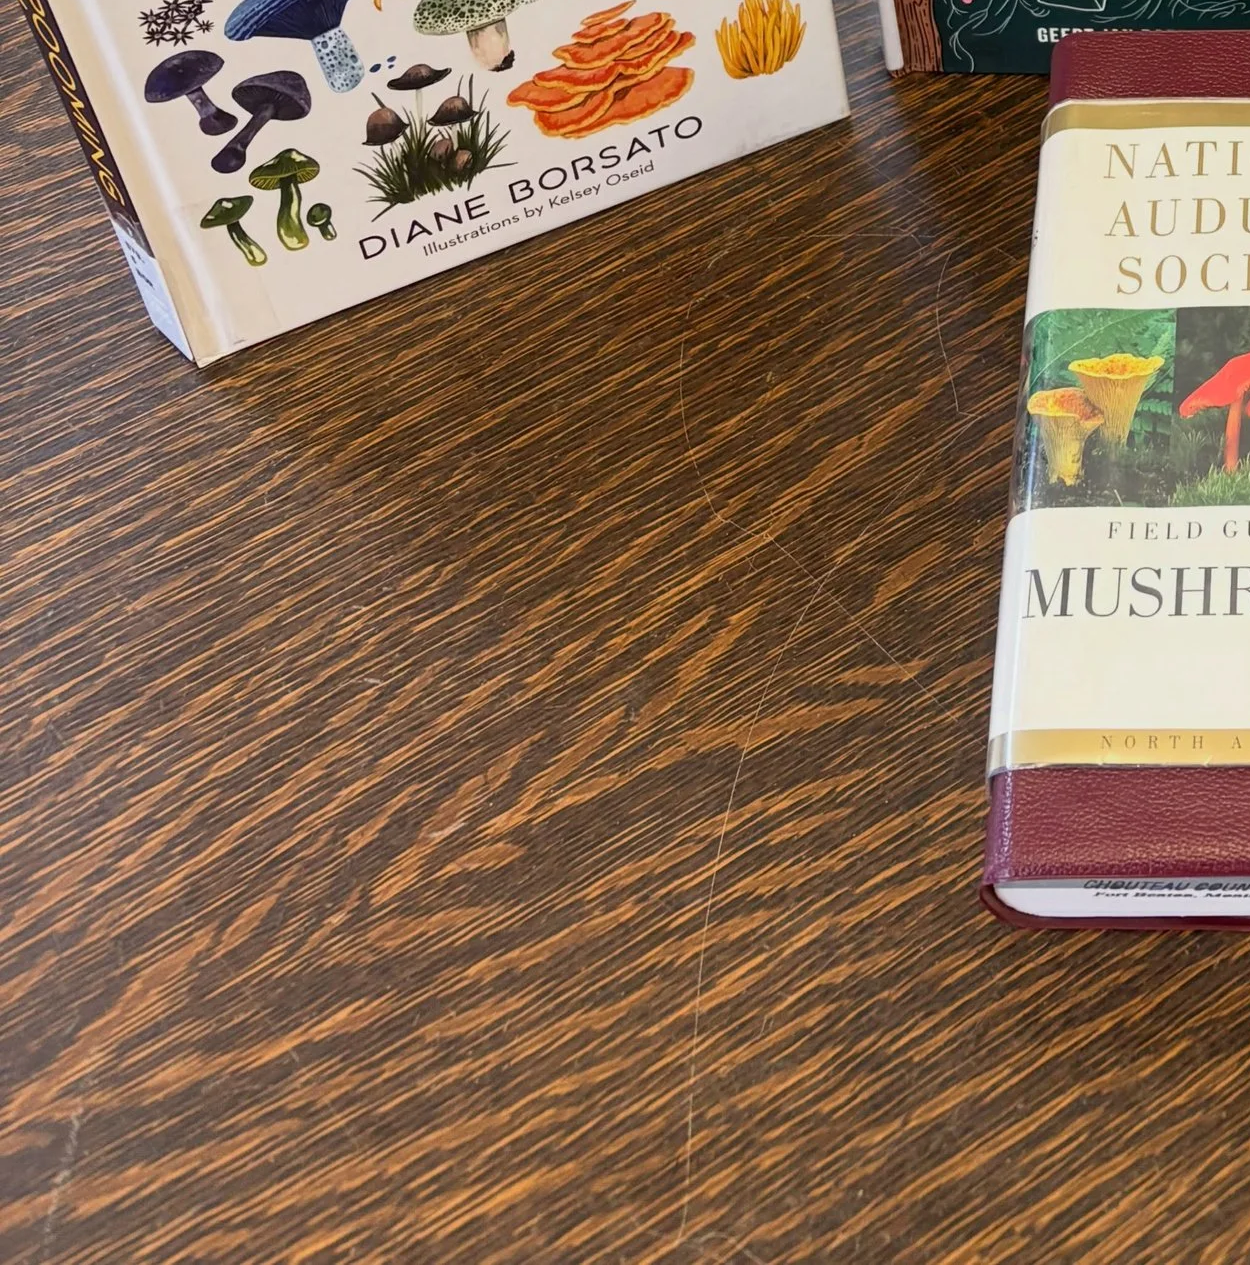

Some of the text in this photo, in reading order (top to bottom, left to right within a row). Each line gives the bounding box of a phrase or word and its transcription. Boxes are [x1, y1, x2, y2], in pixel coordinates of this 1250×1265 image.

[358, 116, 703, 260] DIANE BORSATO
[422, 160, 655, 257] Illustrations by Kelsey Oseid
[1108, 520, 1205, 540] FIELD
[1100, 735, 1205, 751] NORTH
[1083, 879, 1191, 891] CHOUTEAU
